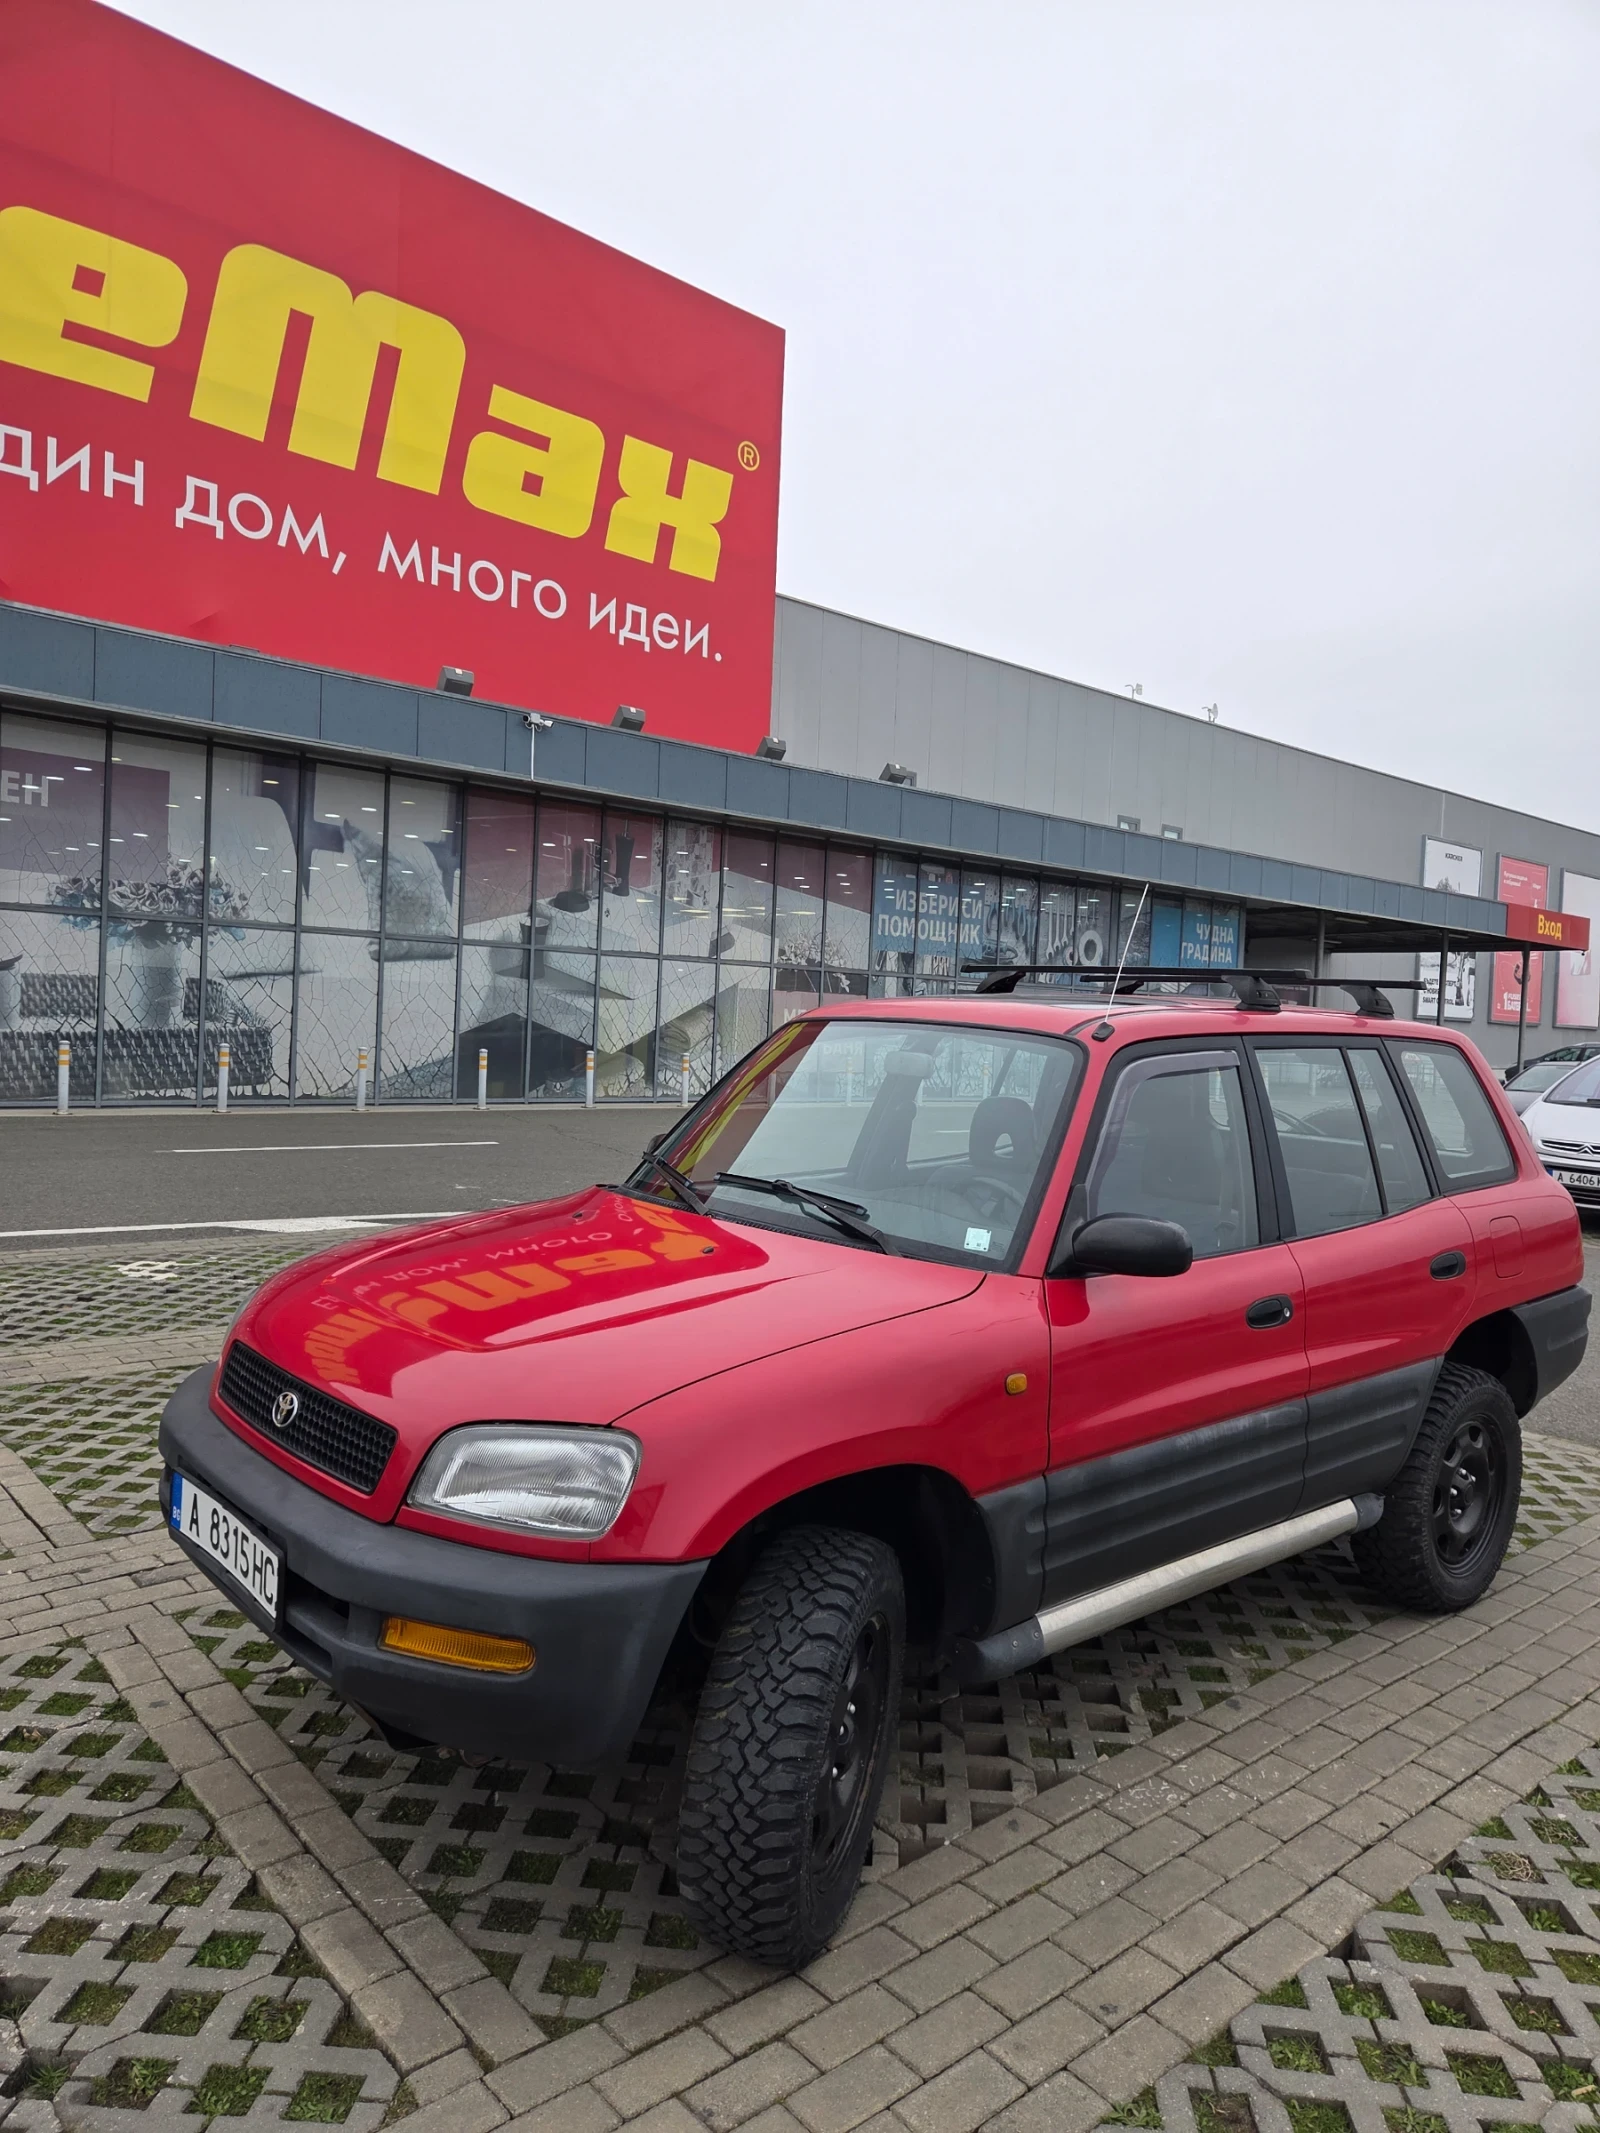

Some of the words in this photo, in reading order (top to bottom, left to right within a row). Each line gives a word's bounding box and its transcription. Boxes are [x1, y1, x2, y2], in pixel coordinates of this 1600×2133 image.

[175, 474, 346, 575] дом,
[377, 531, 567, 620] много
[588, 592, 723, 662] идеи.
[895, 888, 957, 917] ИЗБЕРИ
[960, 897, 983, 920] СИ
[877, 913, 982, 946] ПОМОЩНИК
[1196, 922, 1234, 946] ЧУДНА
[1537, 914, 1562, 941] Вход
[1181, 941, 1233, 965] ГРАДИНА
[1557, 1172, 1564, 1182] A
[172, 1506, 181, 1521] BG
[189, 1493, 200, 1538] A
